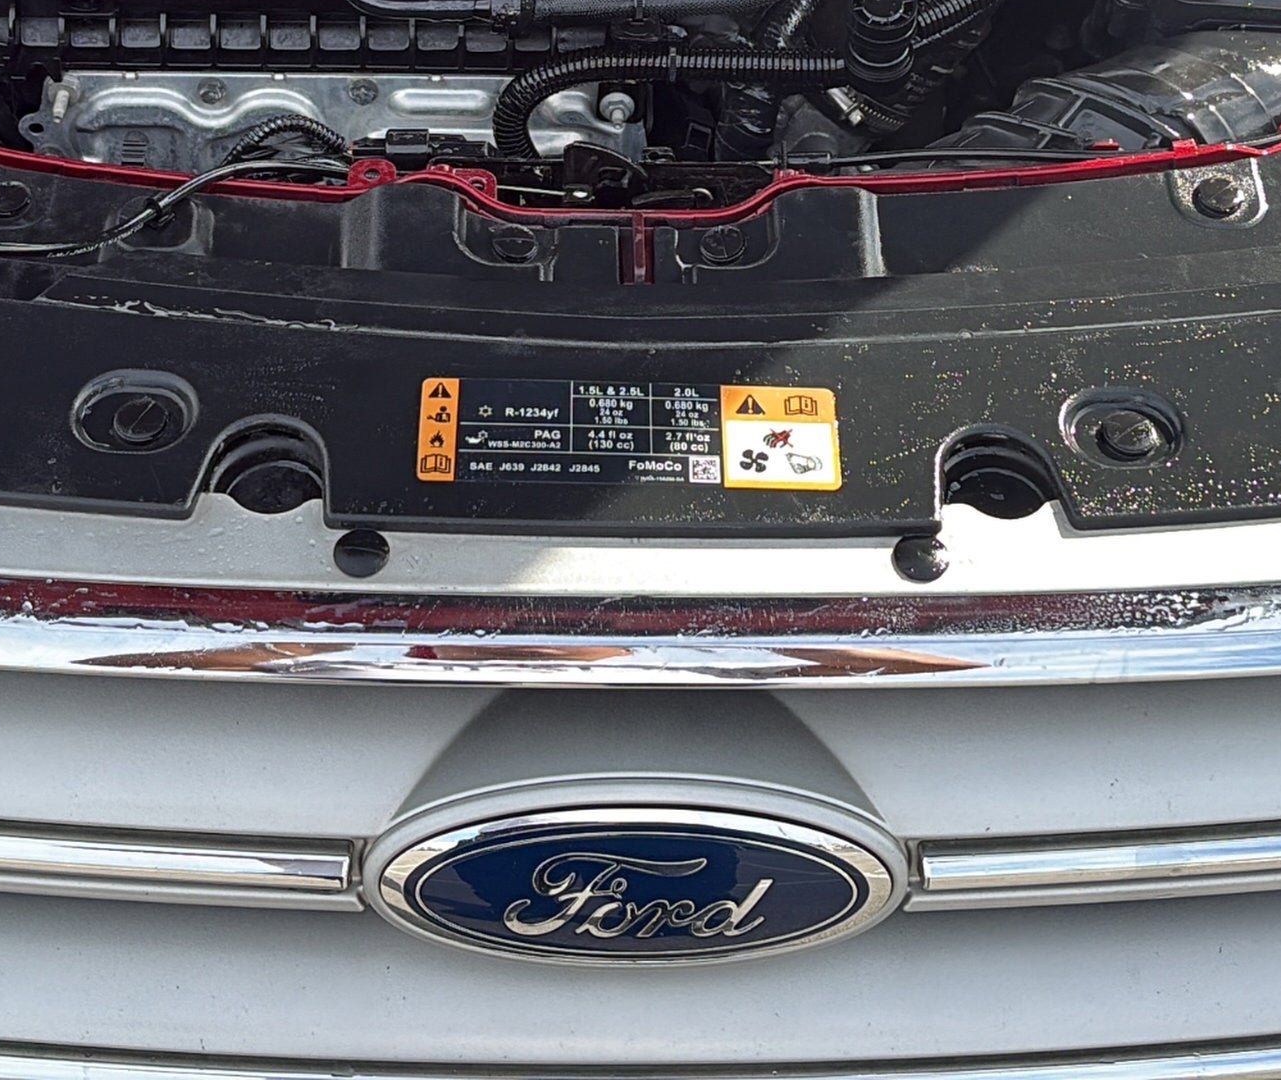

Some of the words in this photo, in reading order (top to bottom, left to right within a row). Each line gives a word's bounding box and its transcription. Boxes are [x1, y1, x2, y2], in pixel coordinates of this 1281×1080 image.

[579, 386, 603, 396] 1.5L
[619, 387, 645, 397] 2.5L
[674, 387, 699, 397] 2.0L
[589, 398, 617, 408] 0.680
[619, 399, 633, 411] kg
[665, 400, 693, 410] 0.680
[695, 401, 709, 412] kg
[504, 407, 559, 420] R-1234yf
[614, 417, 629, 425] lbs
[670, 418, 688, 426] 1.50
[534, 430, 561, 440] PAG
[588, 430, 605, 438] 4.4
[608, 430, 616, 438] fl
[619, 431, 633, 439] oz
[665, 432, 682, 441] 2.7
[695, 434, 711, 442] oz
[588, 439, 613, 450] (130
[616, 441, 634, 450] cc)
[670, 441, 687, 452] (80
[690, 442, 709, 452] cc)
[470, 462, 493, 471] SAE
[499, 462, 525, 471] J639
[530, 463, 561, 472] J2842
[569, 464, 600, 473] J2845
[628, 460, 682, 471] FoMoCo
[503, 851, 774, 938] Ford
